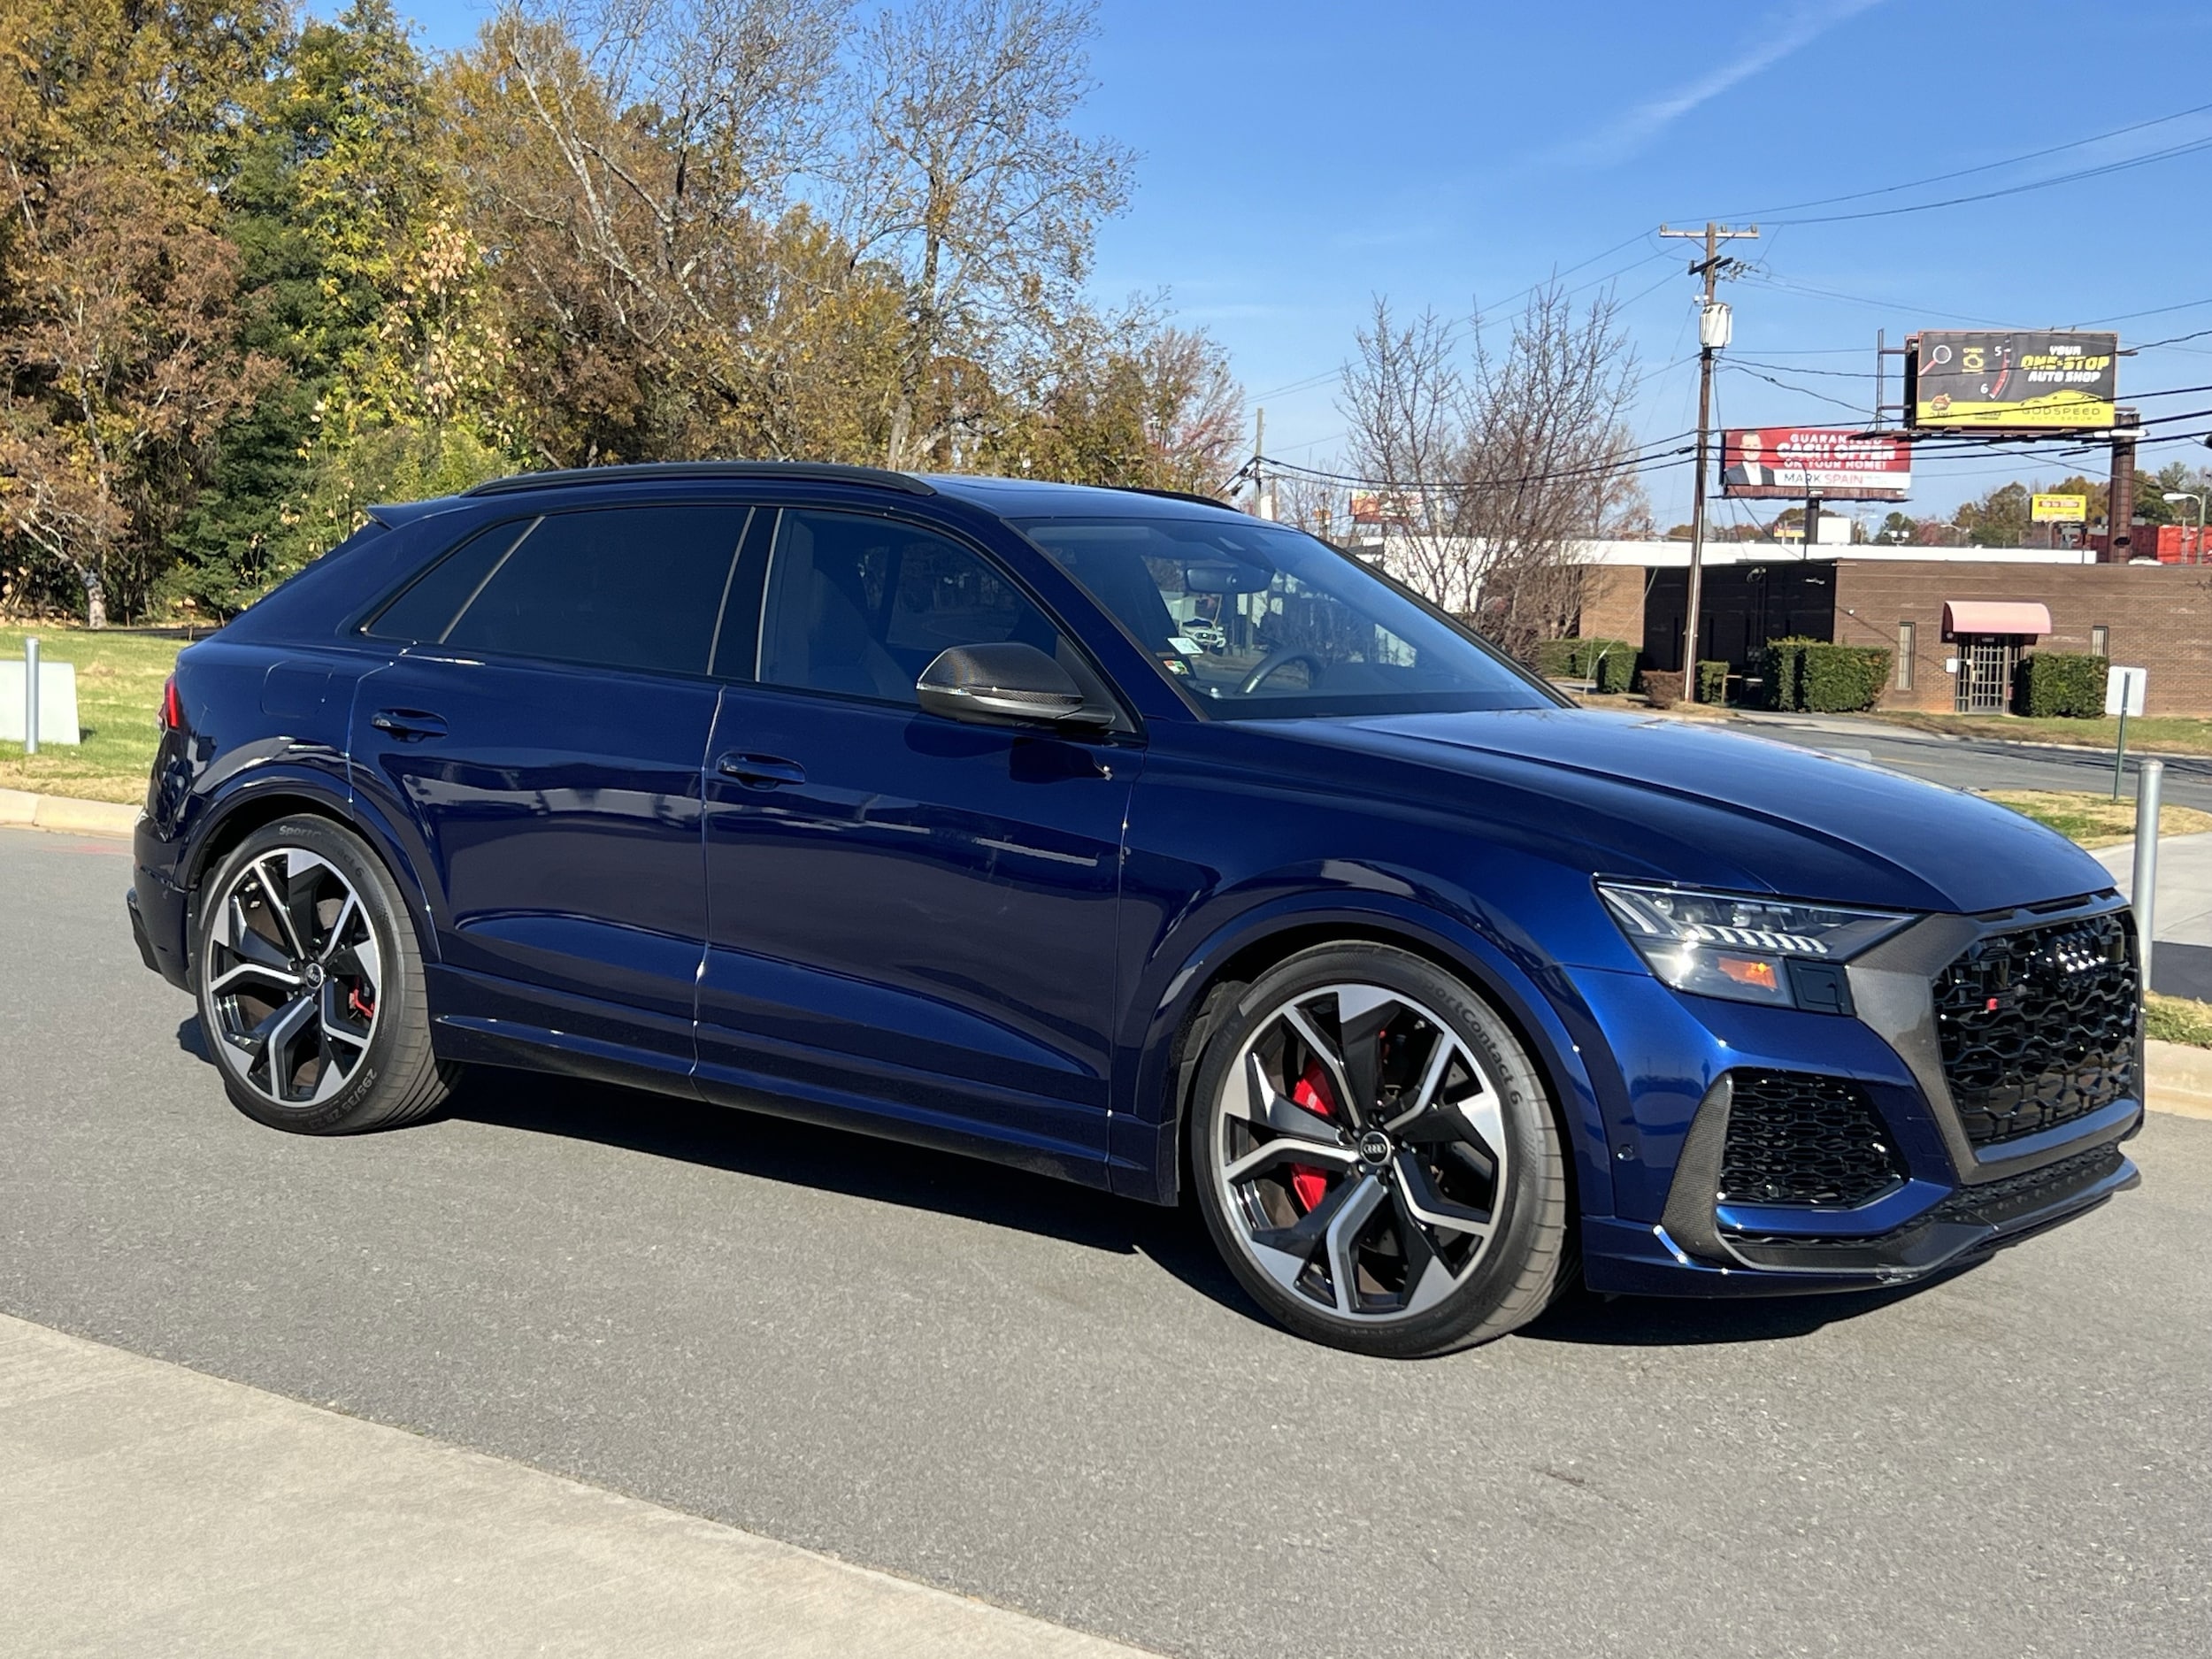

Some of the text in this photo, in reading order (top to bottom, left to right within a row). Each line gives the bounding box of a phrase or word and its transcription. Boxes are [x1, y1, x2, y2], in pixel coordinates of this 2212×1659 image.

[1994, 346, 2002, 357] 5
[2049, 345, 2082, 356] YOUR
[2028, 371, 2101, 383] AUTO SHOP
[1980, 383, 1989, 394] 6
[1776, 442, 1896, 460] CASH OFFER
[1784, 458, 1886, 470] ON YOUR HOME!
[1784, 473, 1821, 483] MARK
[1824, 474, 1863, 484] SPAIN
[279, 825, 354, 867] SportCact
[355, 867, 365, 878] 6
[1421, 979, 1523, 1105] portContact 6
[342, 1068, 378, 1111] 295/35
